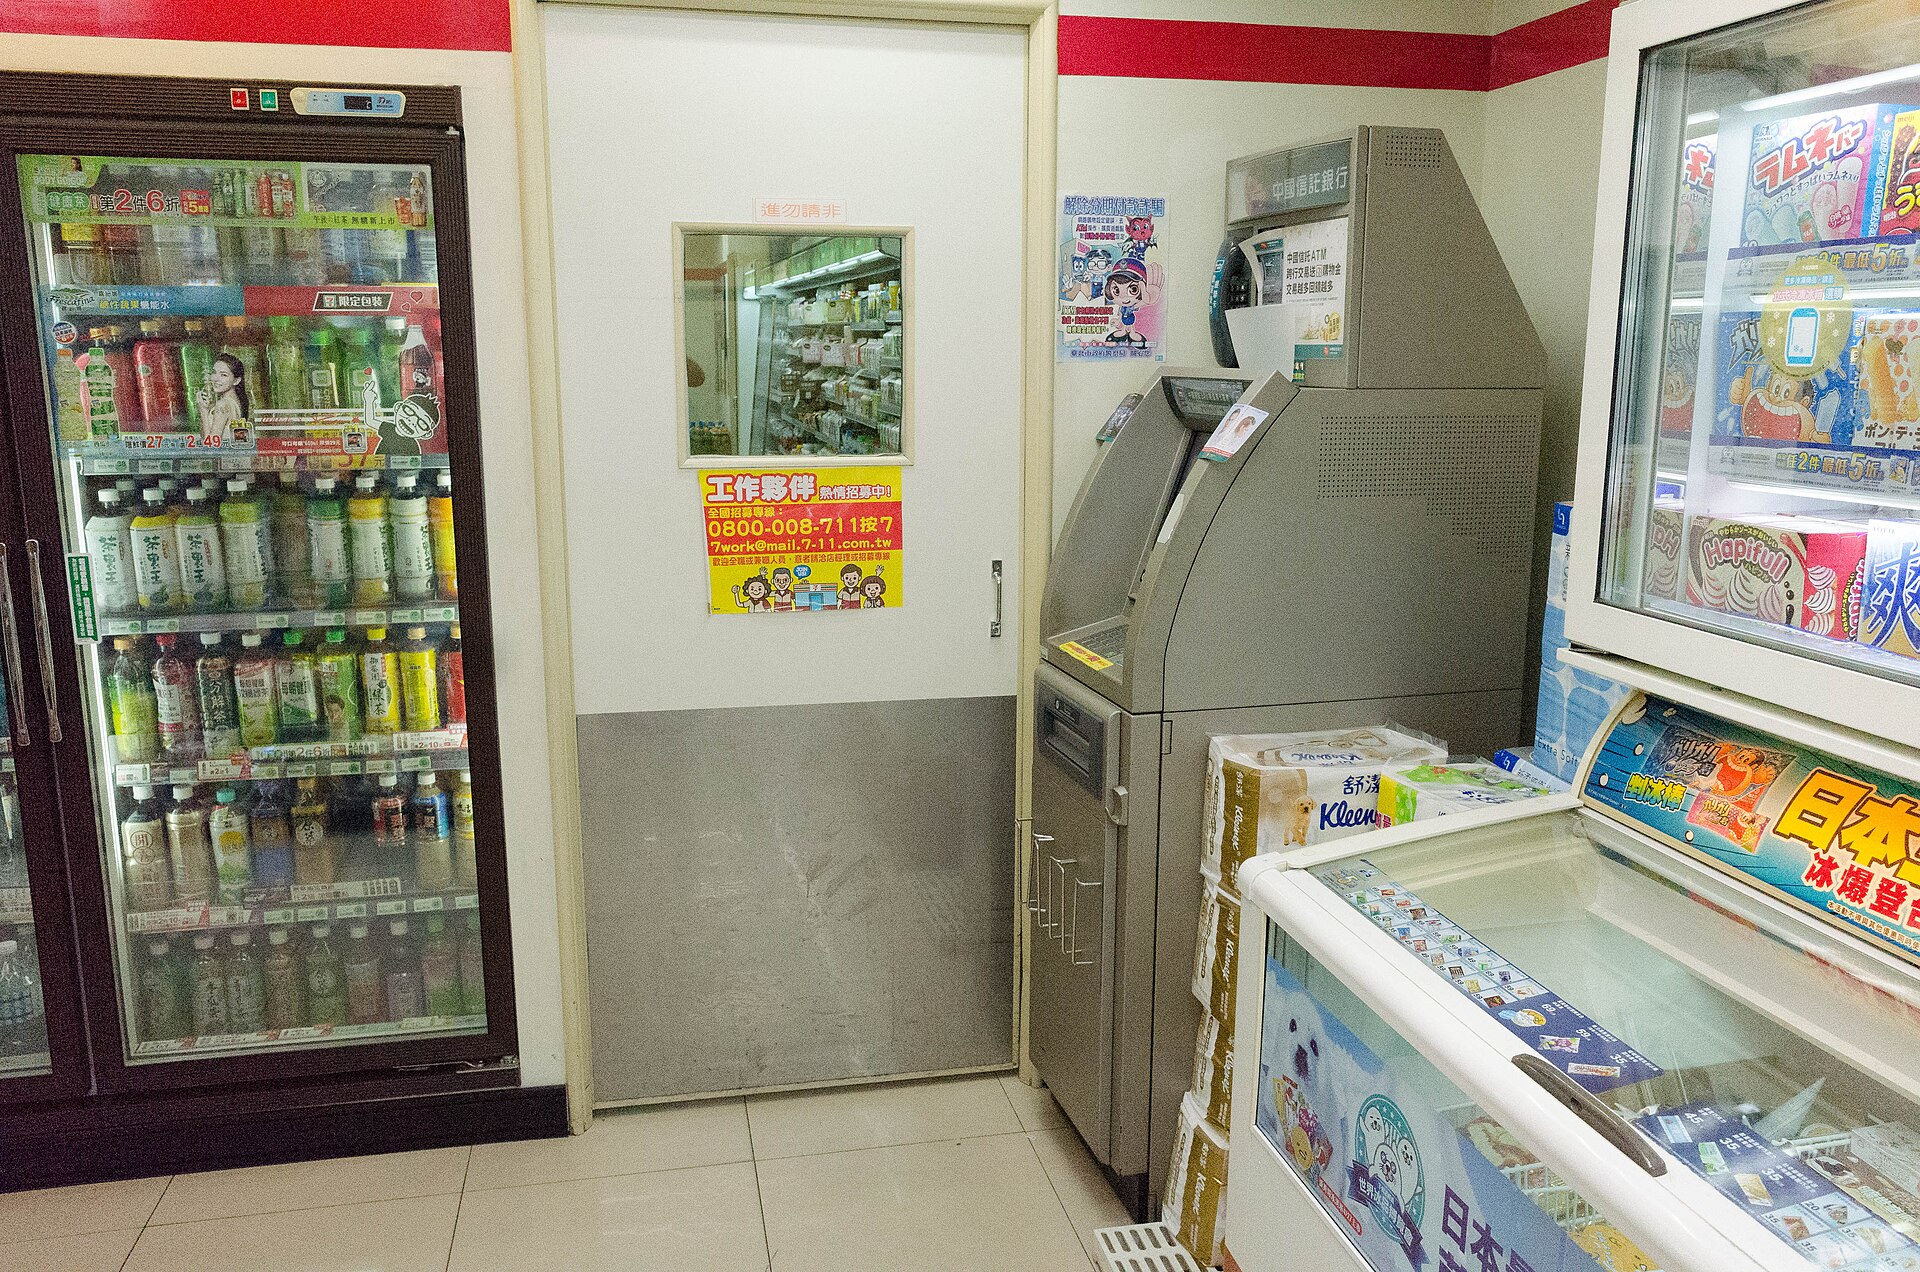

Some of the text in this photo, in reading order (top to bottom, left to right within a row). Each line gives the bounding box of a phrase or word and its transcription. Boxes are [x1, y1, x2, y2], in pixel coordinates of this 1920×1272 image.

[1753, 122, 1864, 192] ラムネバー
[1272, 166, 1348, 201] 中國信託銀行
[99, 188, 180, 214] 第2件6折
[1064, 196, 1164, 216] 解除分期付款詐騙
[1287, 248, 1327, 264] 中國信託ATM
[1286, 280, 1334, 295] 交易越多回饋越多
[338, 296, 384, 307] 限定包裝
[706, 473, 892, 503] 工作夥伴 熱情招募中!
[710, 538, 892, 553] 7work@mail.7-11.com.tw
[1702, 538, 1791, 583] Hapifull
[1537, 736, 1580, 767] Extra Soft
[1343, 775, 1381, 796] 舒潔
[1231, 804, 1244, 851] Kleenex
[1222, 938, 1234, 984] Kleenex
[1575, 1028, 1591, 1039] 59
[1610, 1053, 1628, 1065] 35
[1684, 1112, 1704, 1124] 45
[1718, 1136, 1741, 1151] 35
[1761, 1168, 1784, 1181] 35
